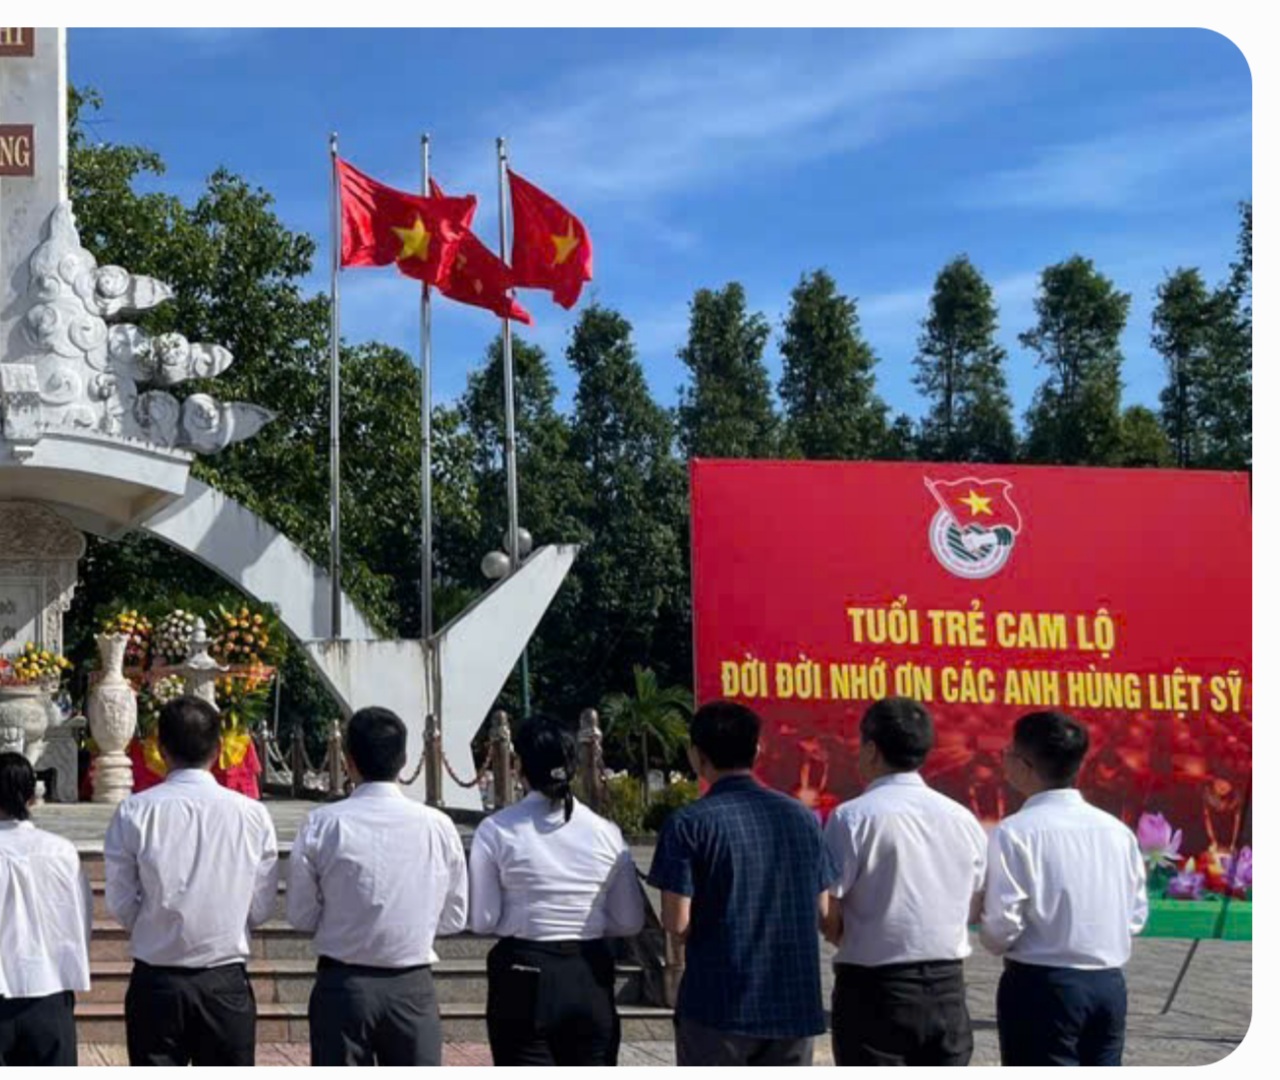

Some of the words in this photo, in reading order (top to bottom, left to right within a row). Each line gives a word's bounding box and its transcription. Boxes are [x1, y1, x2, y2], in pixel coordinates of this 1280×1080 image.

[847, 594, 920, 645] TUỔI
[927, 599, 987, 647] TRẺ
[996, 611, 1068, 650] CAM
[1077, 607, 1115, 659] LỘ
[721, 652, 768, 698] ĐỜI
[775, 653, 823, 699] ĐỜI
[830, 656, 887, 701] NHỚ
[895, 661, 934, 702] ƠN
[941, 660, 996, 704] CÁC
[1004, 668, 1060, 706] ANH
[1067, 664, 1142, 710] HÙNG
[1148, 667, 1202, 719] LIỆT
[1210, 669, 1243, 713] SỸ
